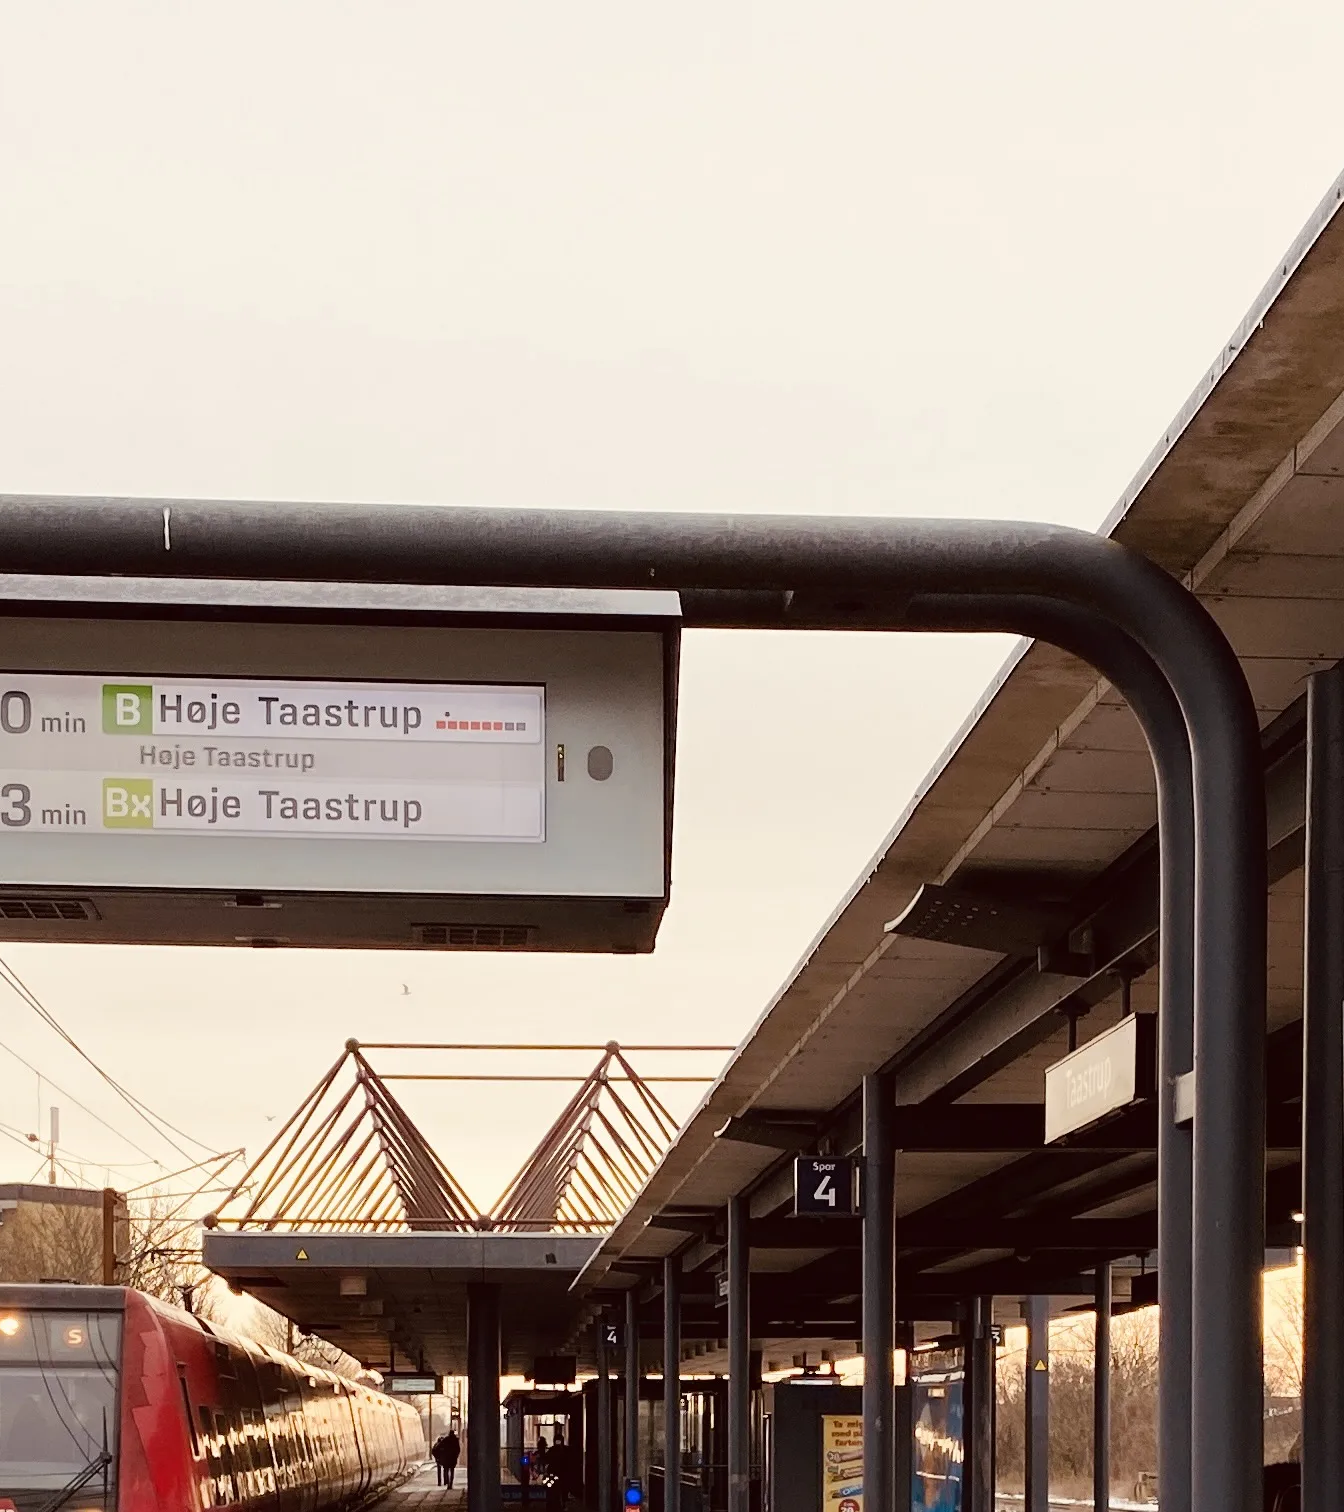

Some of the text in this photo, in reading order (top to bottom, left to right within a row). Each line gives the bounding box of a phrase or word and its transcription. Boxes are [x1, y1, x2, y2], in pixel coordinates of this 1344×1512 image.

[41, 711, 87, 733] min
[115, 692, 141, 726] B
[160, 693, 241, 730] Høje
[258, 696, 422, 735] Taastrup
[139, 744, 316, 773] Høje Taastrup
[41, 803, 87, 825] min
[106, 786, 152, 819] Bx
[160, 786, 242, 824] Høje
[258, 789, 423, 829] Taastrup
[812, 1161, 836, 1173] Spor
[813, 1175, 836, 1207] 4
[606, 1330, 617, 1344] 4
